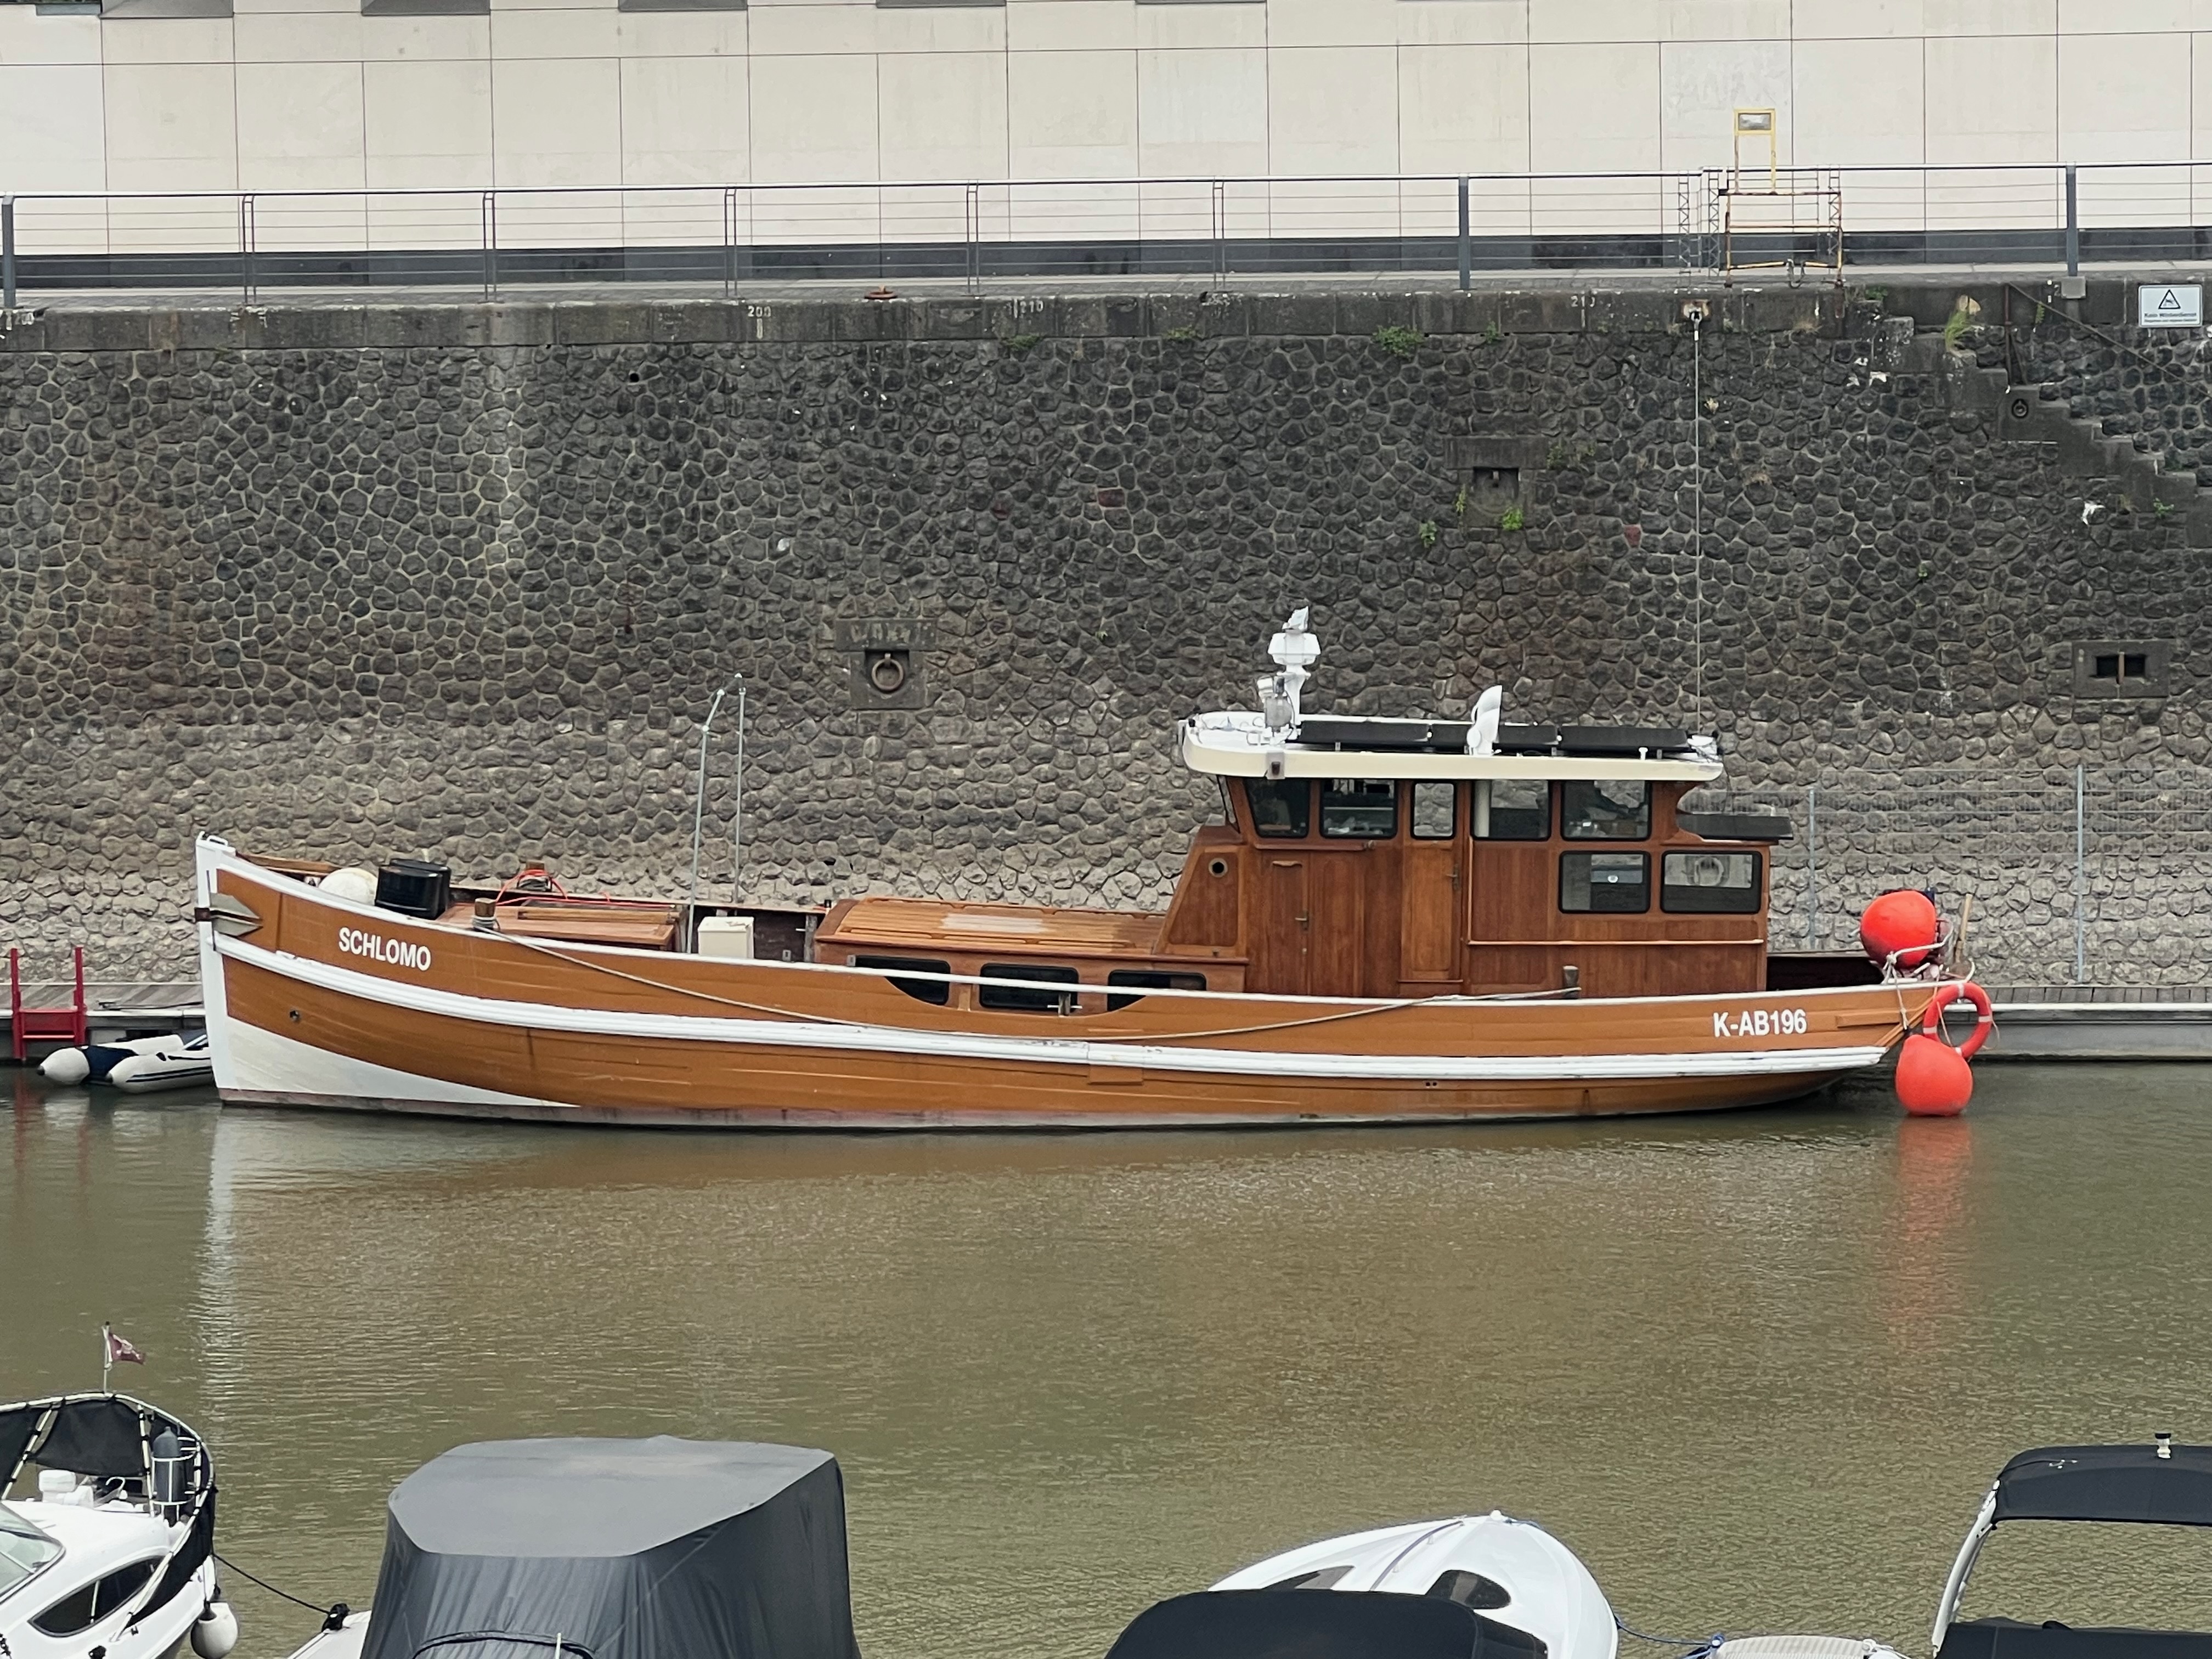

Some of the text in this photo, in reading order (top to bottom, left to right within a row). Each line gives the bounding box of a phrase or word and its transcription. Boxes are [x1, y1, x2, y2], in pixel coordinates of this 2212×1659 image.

[748, 306, 771, 317] 200
[1020, 301, 1043, 313] 210
[338, 927, 431, 971] SCHLOMO
[1713, 1009, 1807, 1037] K-AB196
